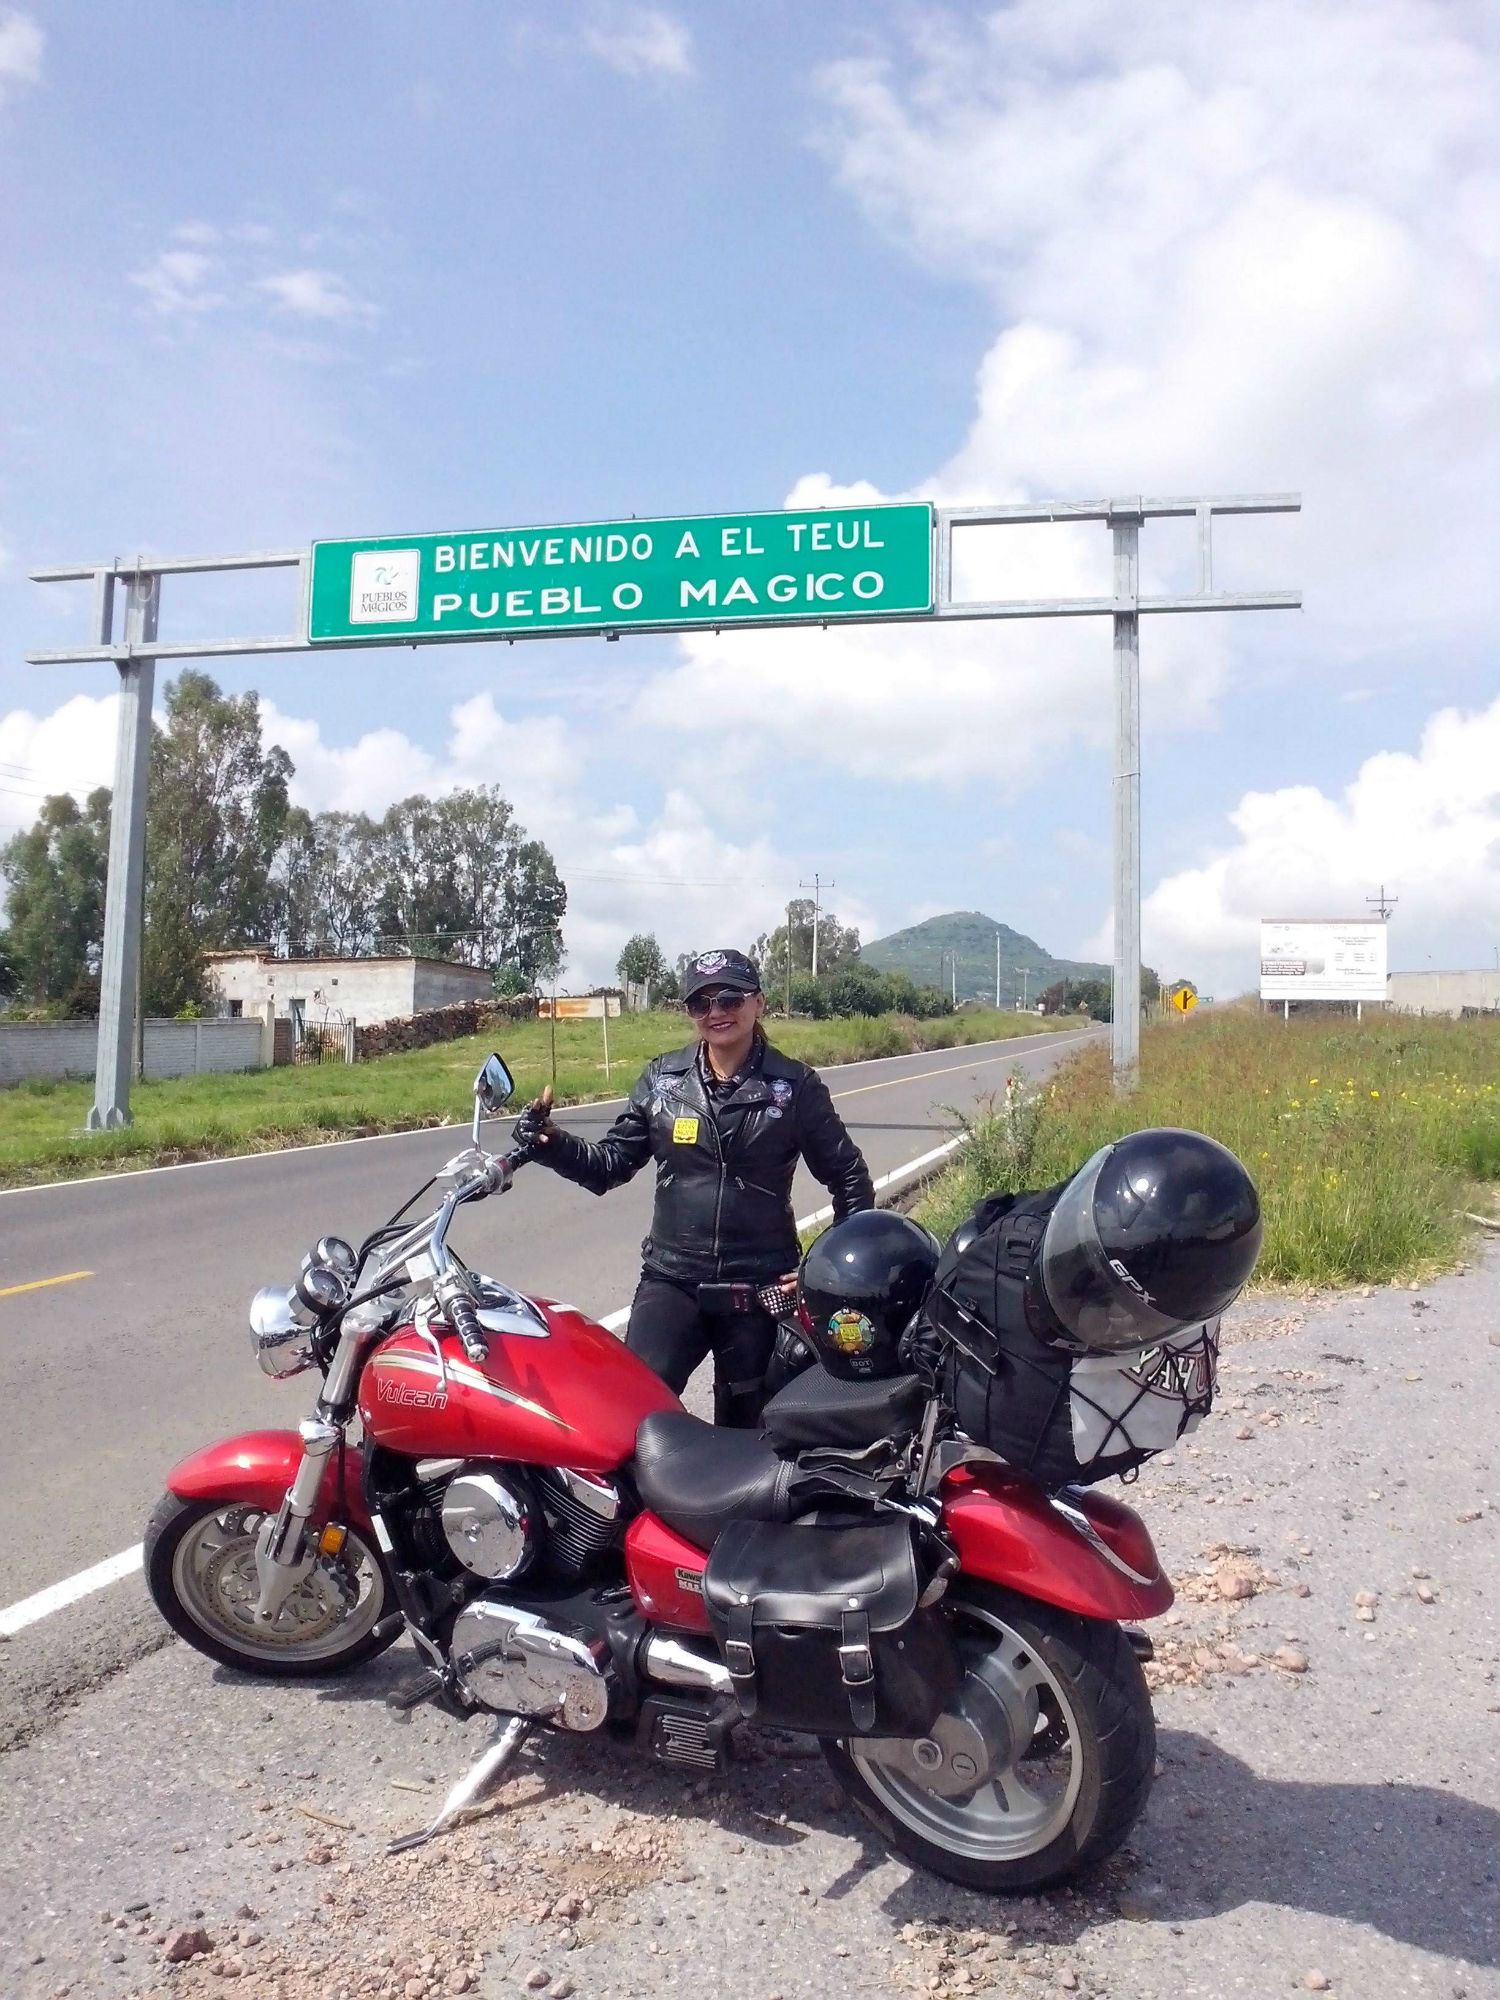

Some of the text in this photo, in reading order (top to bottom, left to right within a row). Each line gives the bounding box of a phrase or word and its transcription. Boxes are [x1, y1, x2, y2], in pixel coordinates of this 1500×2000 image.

[434, 520, 885, 573] BIENVENIDO A EL TEUL
[361, 591, 408, 603] PUEBLOS
[432, 571, 885, 621] PUEBLO MAGICO
[1109, 1259, 1157, 1303] GPX
[377, 1378, 448, 1410] Vulcan
